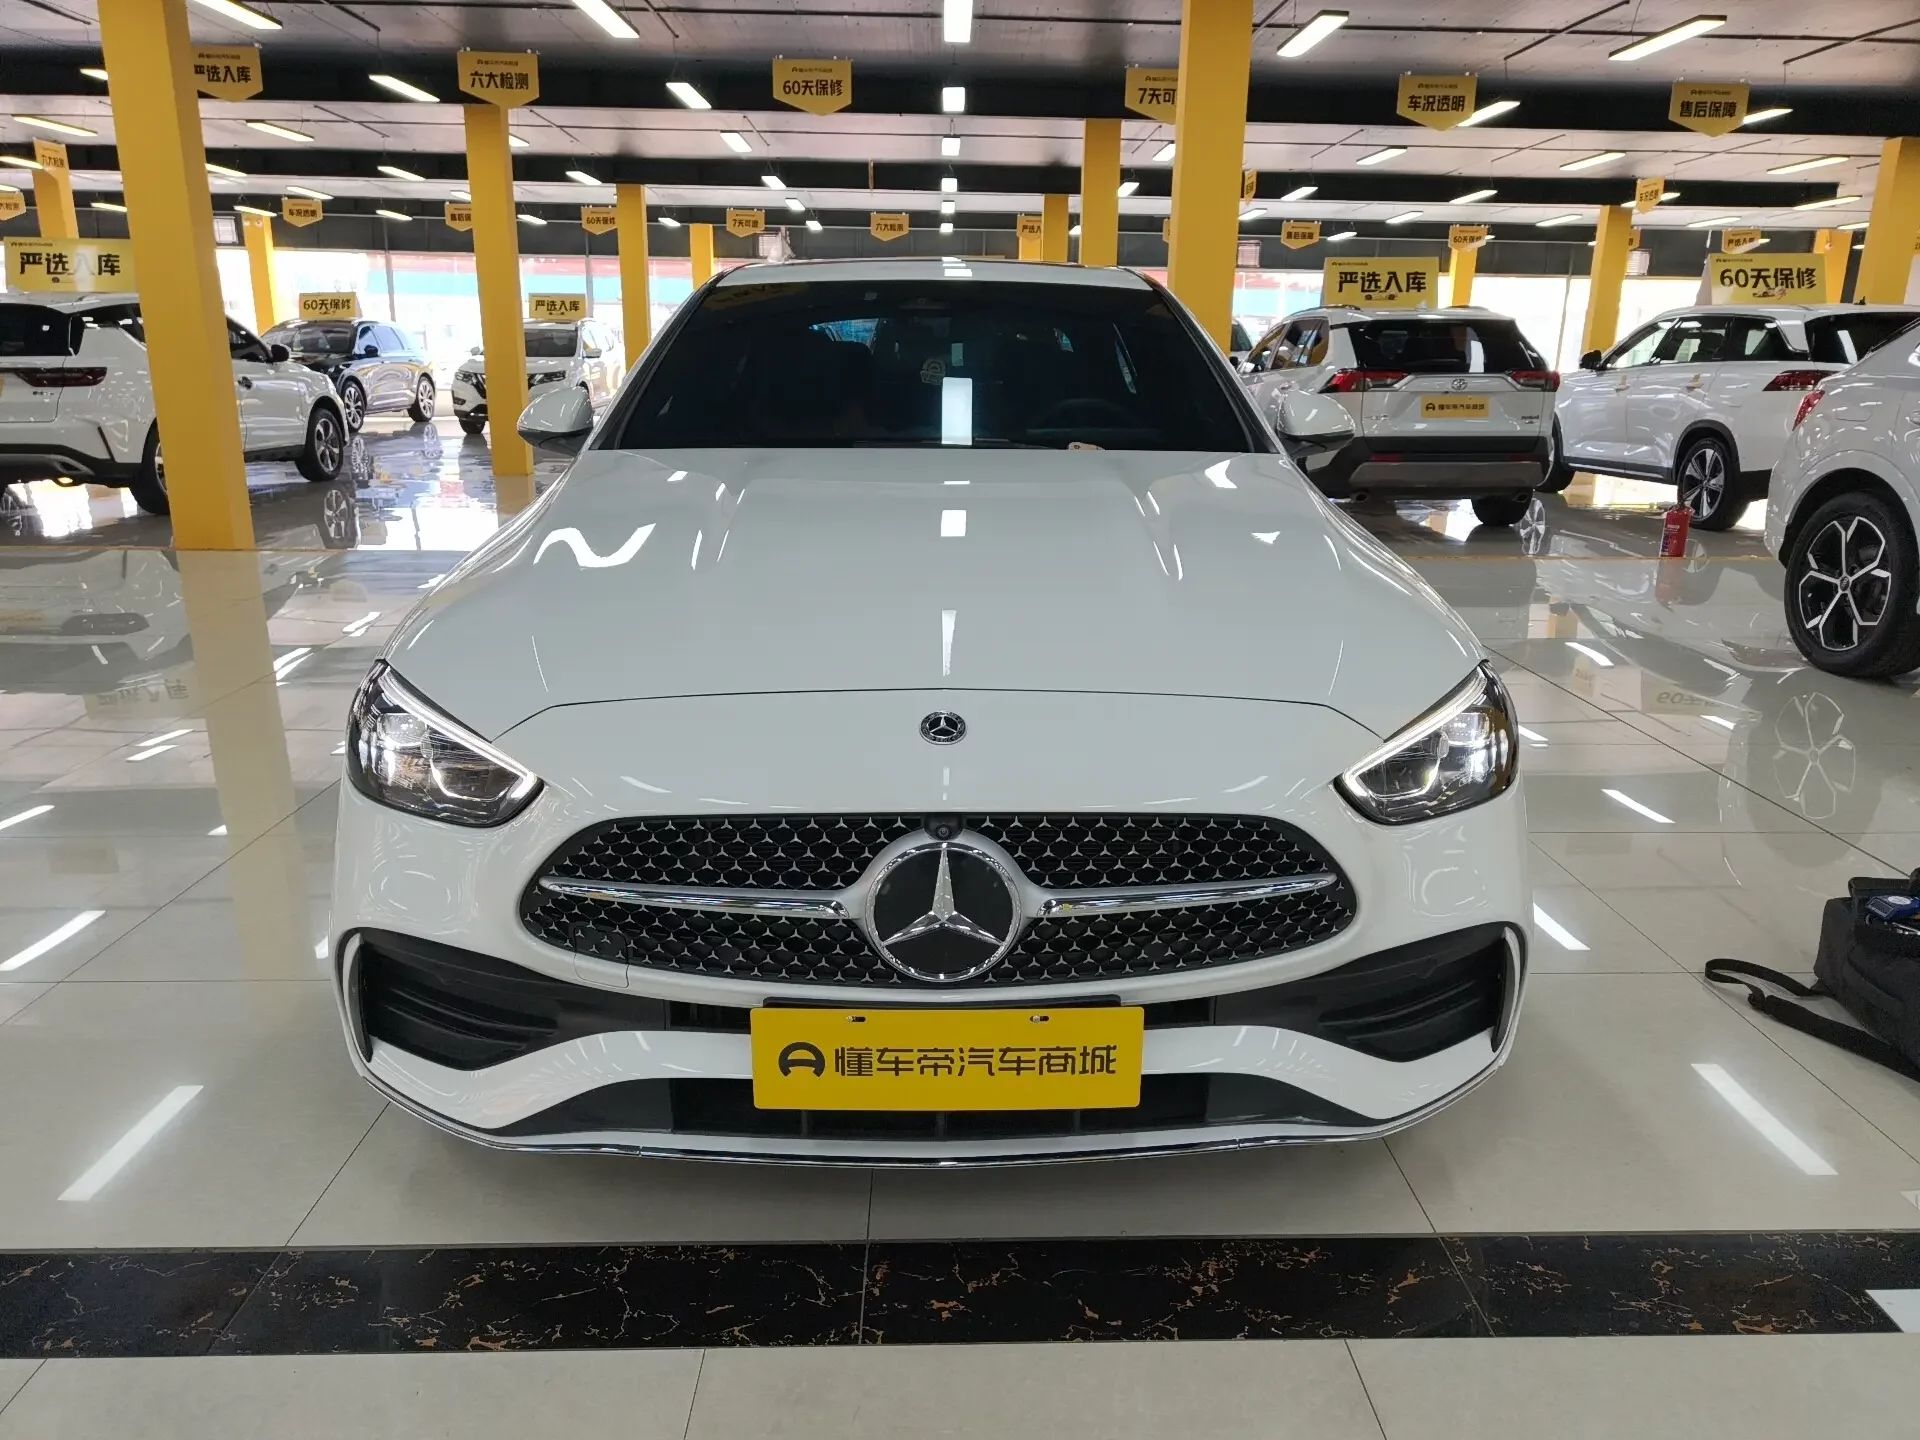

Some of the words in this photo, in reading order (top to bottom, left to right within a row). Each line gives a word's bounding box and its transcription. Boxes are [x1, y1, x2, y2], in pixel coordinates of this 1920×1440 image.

[470, 71, 528, 90] 六大检测
[783, 79, 844, 96] 60天保修
[1408, 95, 1465, 112] 车况透明
[1680, 101, 1737, 118] 售后保障
[20, 252, 121, 275] 严选入库
[1338, 271, 1427, 293] 严选入库
[1720, 267, 1817, 289] 60天保修
[303, 299, 352, 311] 60天保修
[535, 299, 580, 312] 严选入库
[834, 1044, 1118, 1078] 懂车帝汽车商城
